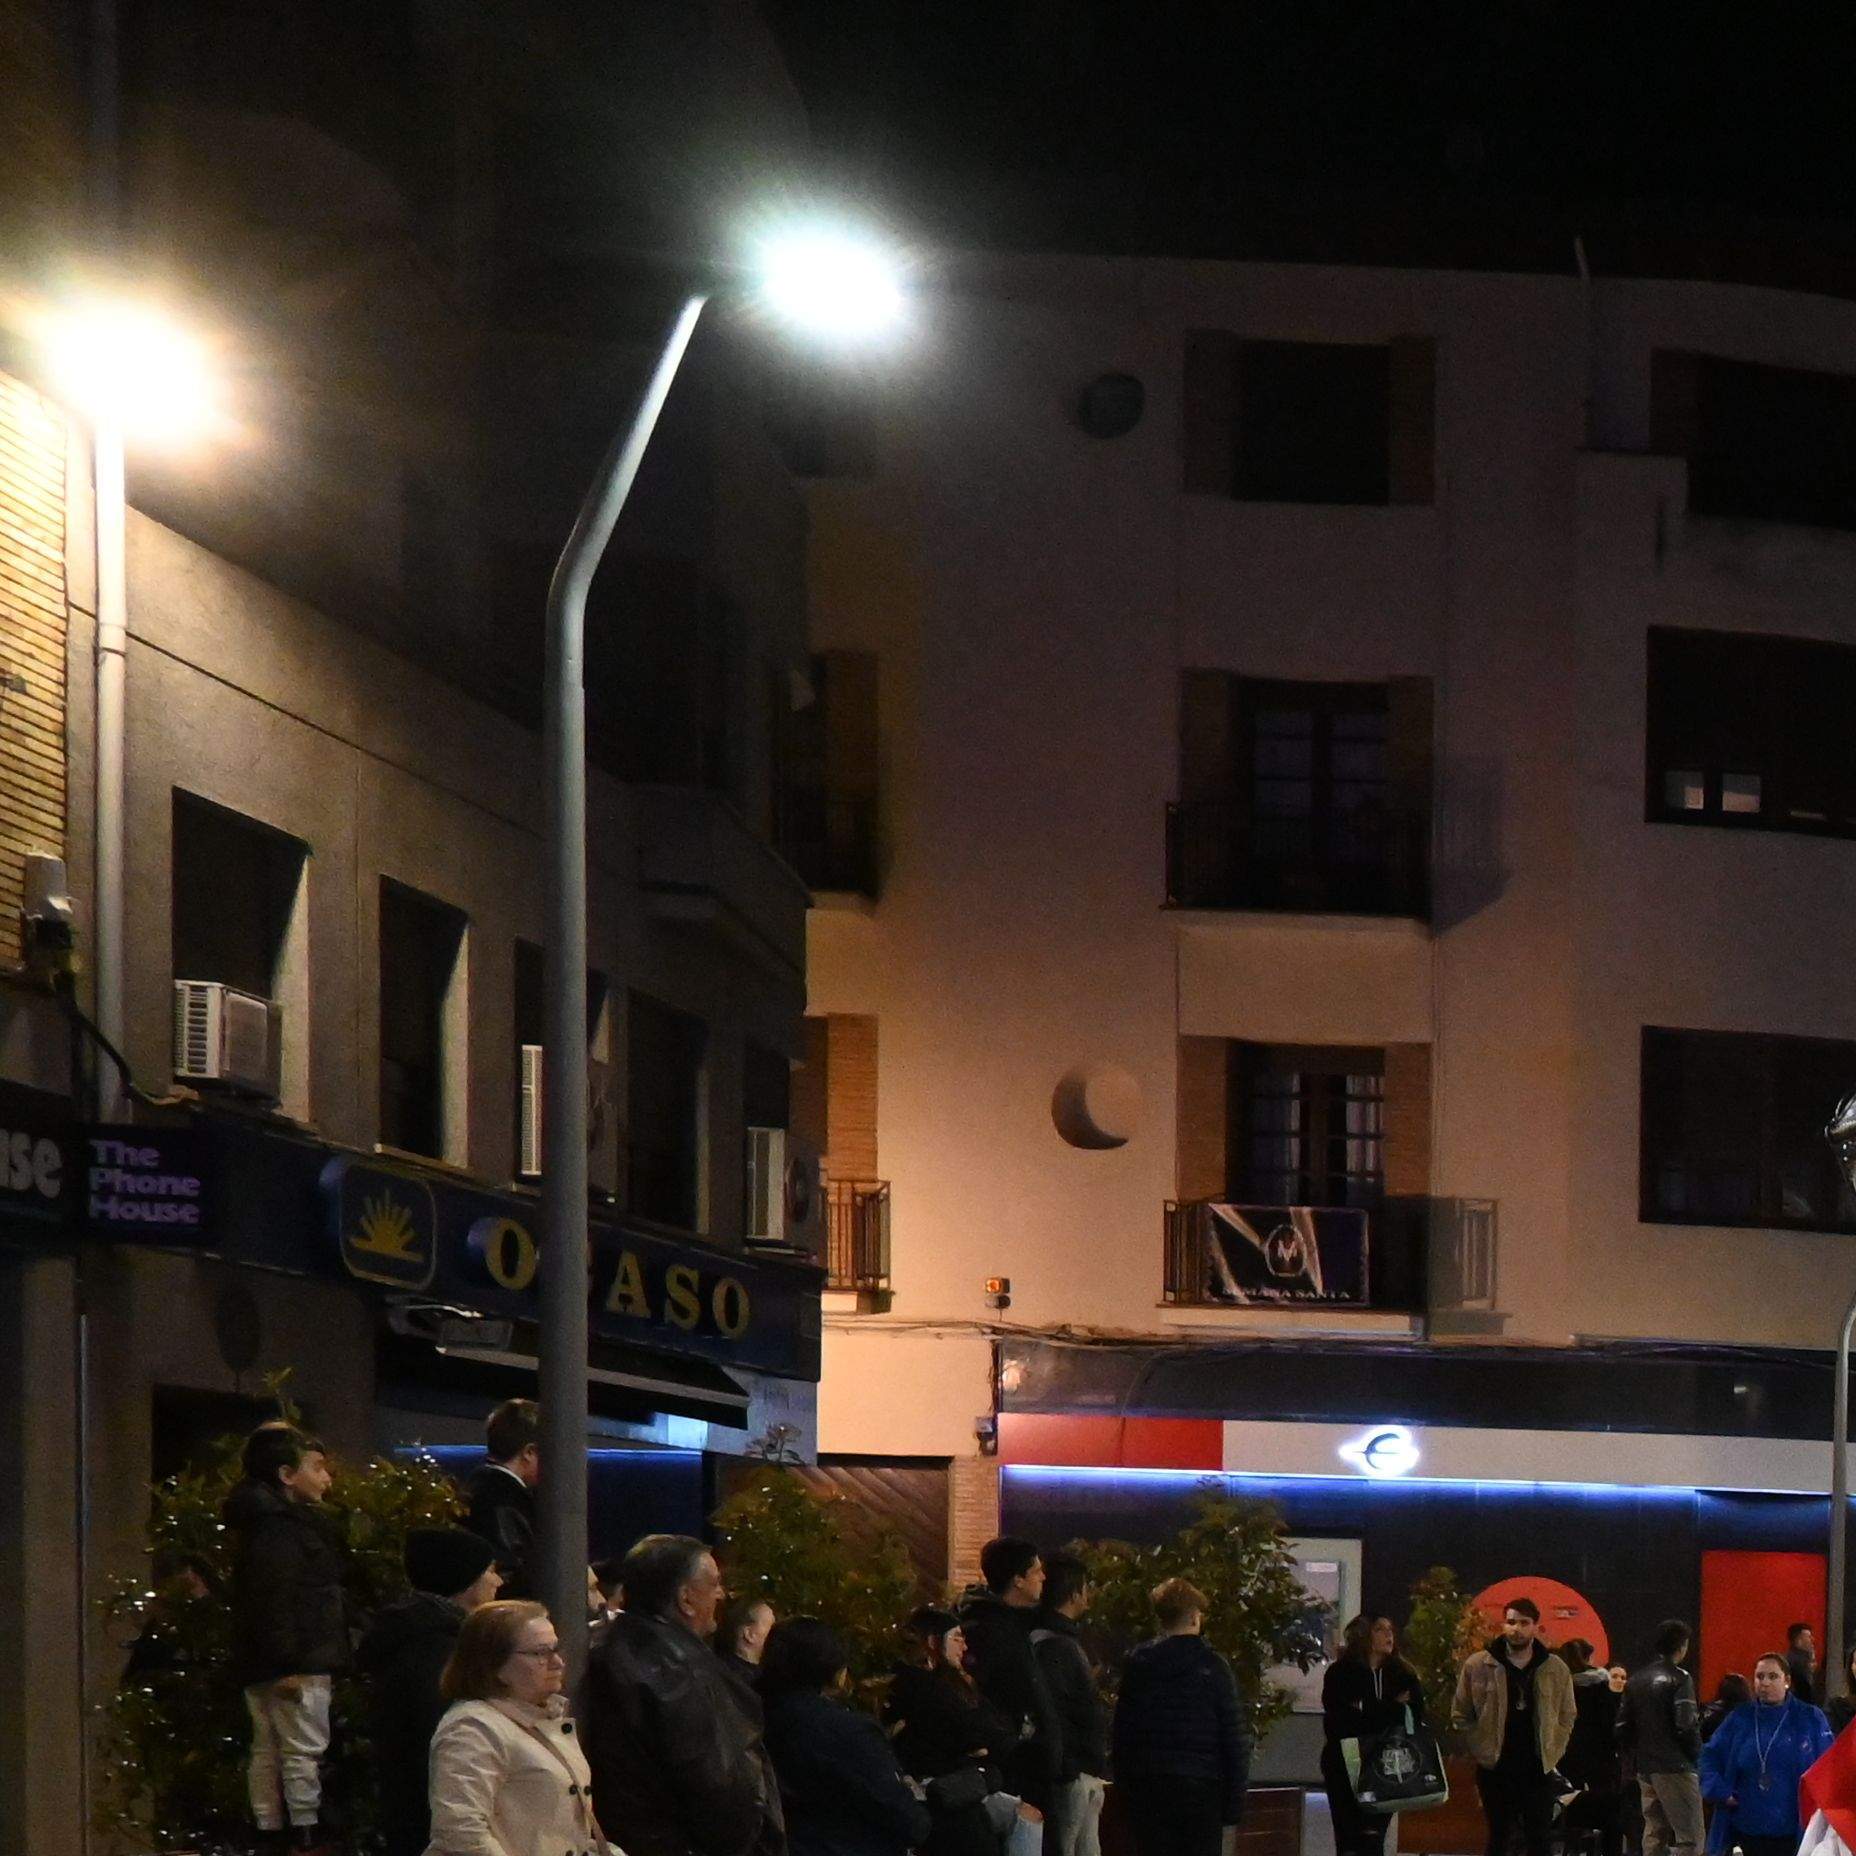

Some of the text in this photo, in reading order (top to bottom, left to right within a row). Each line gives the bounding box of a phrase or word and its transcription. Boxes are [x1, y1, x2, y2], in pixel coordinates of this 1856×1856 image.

[88, 1138, 160, 1168] The
[88, 1166, 201, 1197] Phone
[88, 1195, 200, 1225] House
[485, 1216, 750, 1340] OASO
